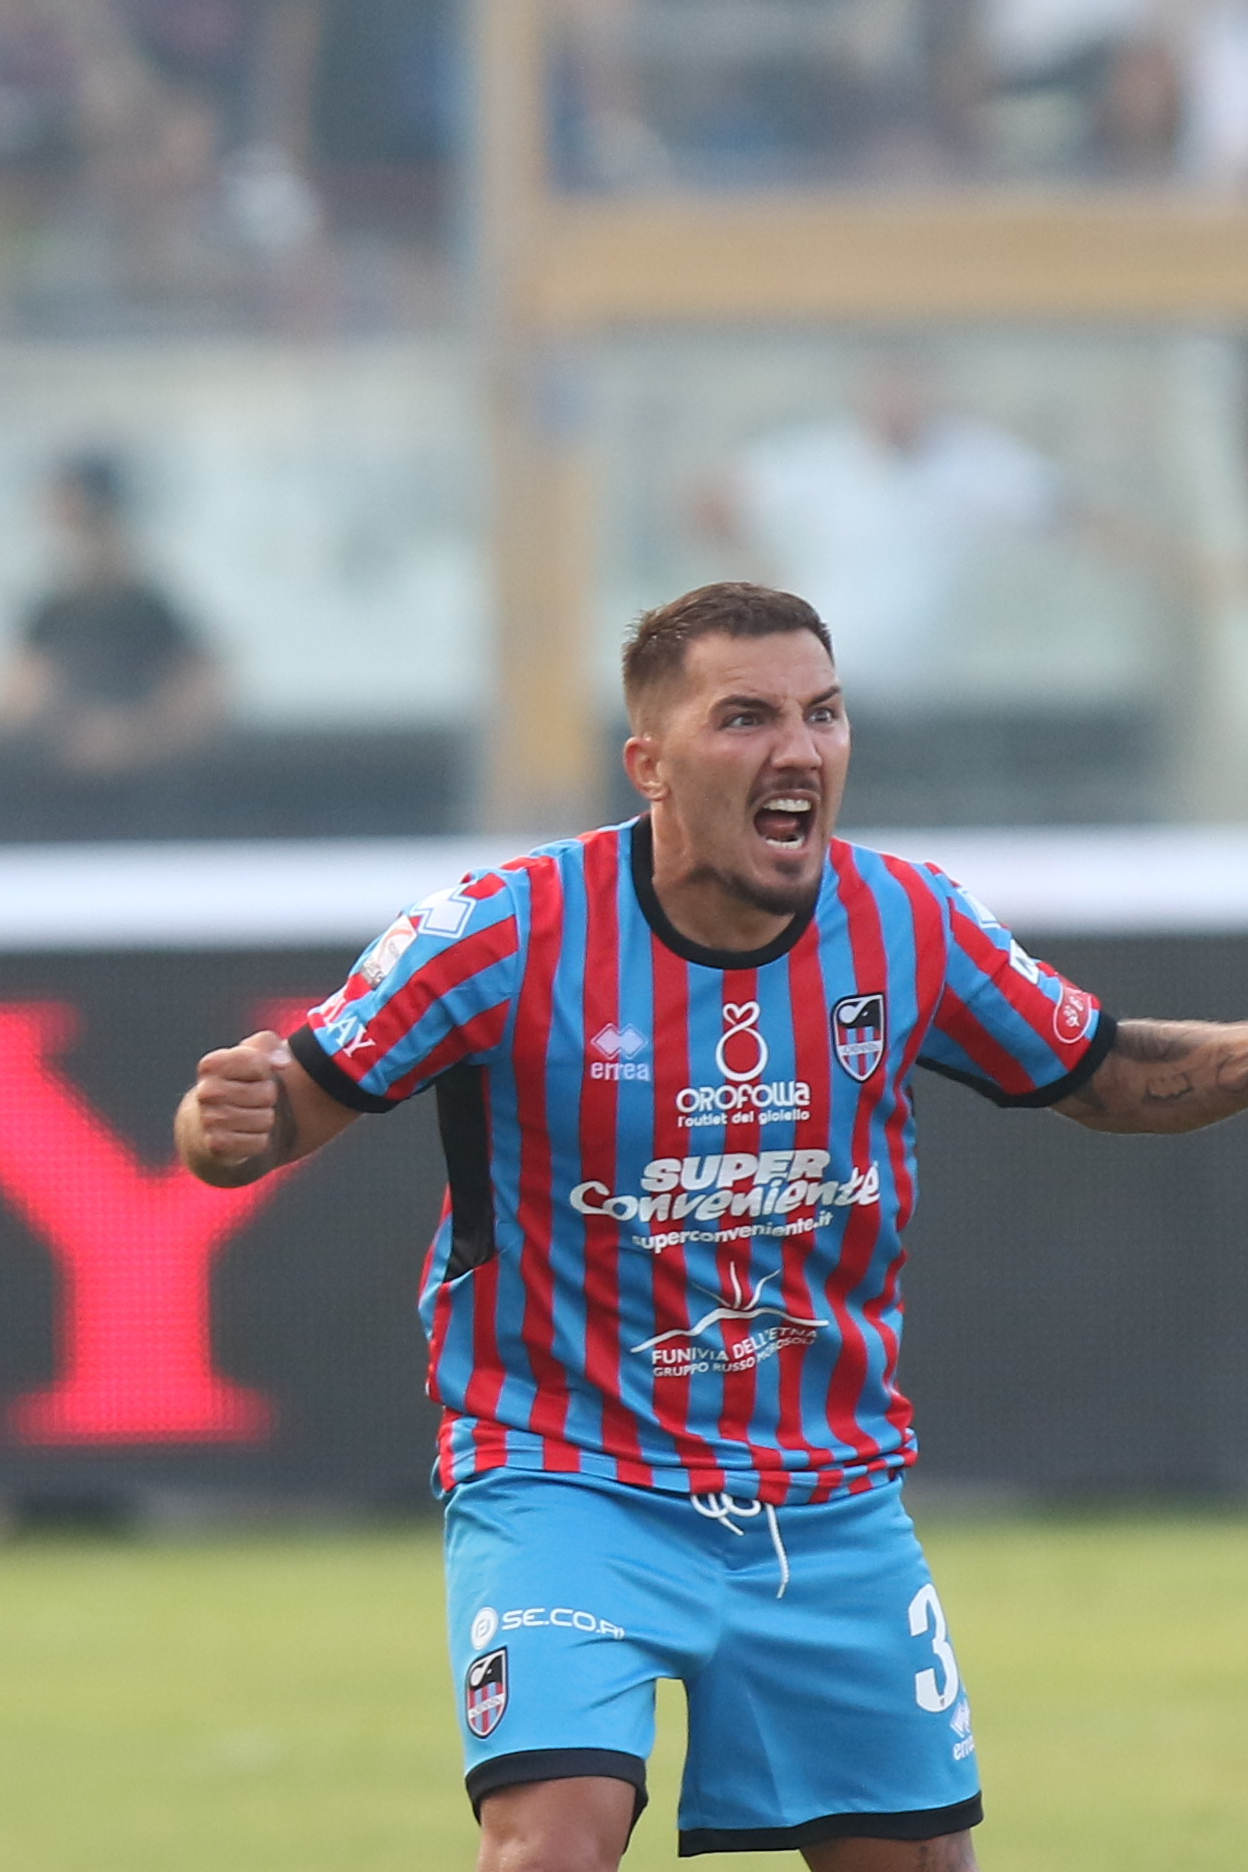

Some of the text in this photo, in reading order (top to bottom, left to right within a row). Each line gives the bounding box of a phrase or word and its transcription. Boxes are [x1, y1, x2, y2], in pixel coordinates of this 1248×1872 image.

[731, 1110, 755, 1125] del
[640, 1149, 832, 1192] SUPER
[632, 1211, 834, 1254] superconveniente.it
[651, 1347, 729, 1366] FUNIVIA
[652, 1361, 710, 1377] GRUPPO
[712, 1356, 757, 1374] RUSSO
[908, 1583, 959, 1713] 3
